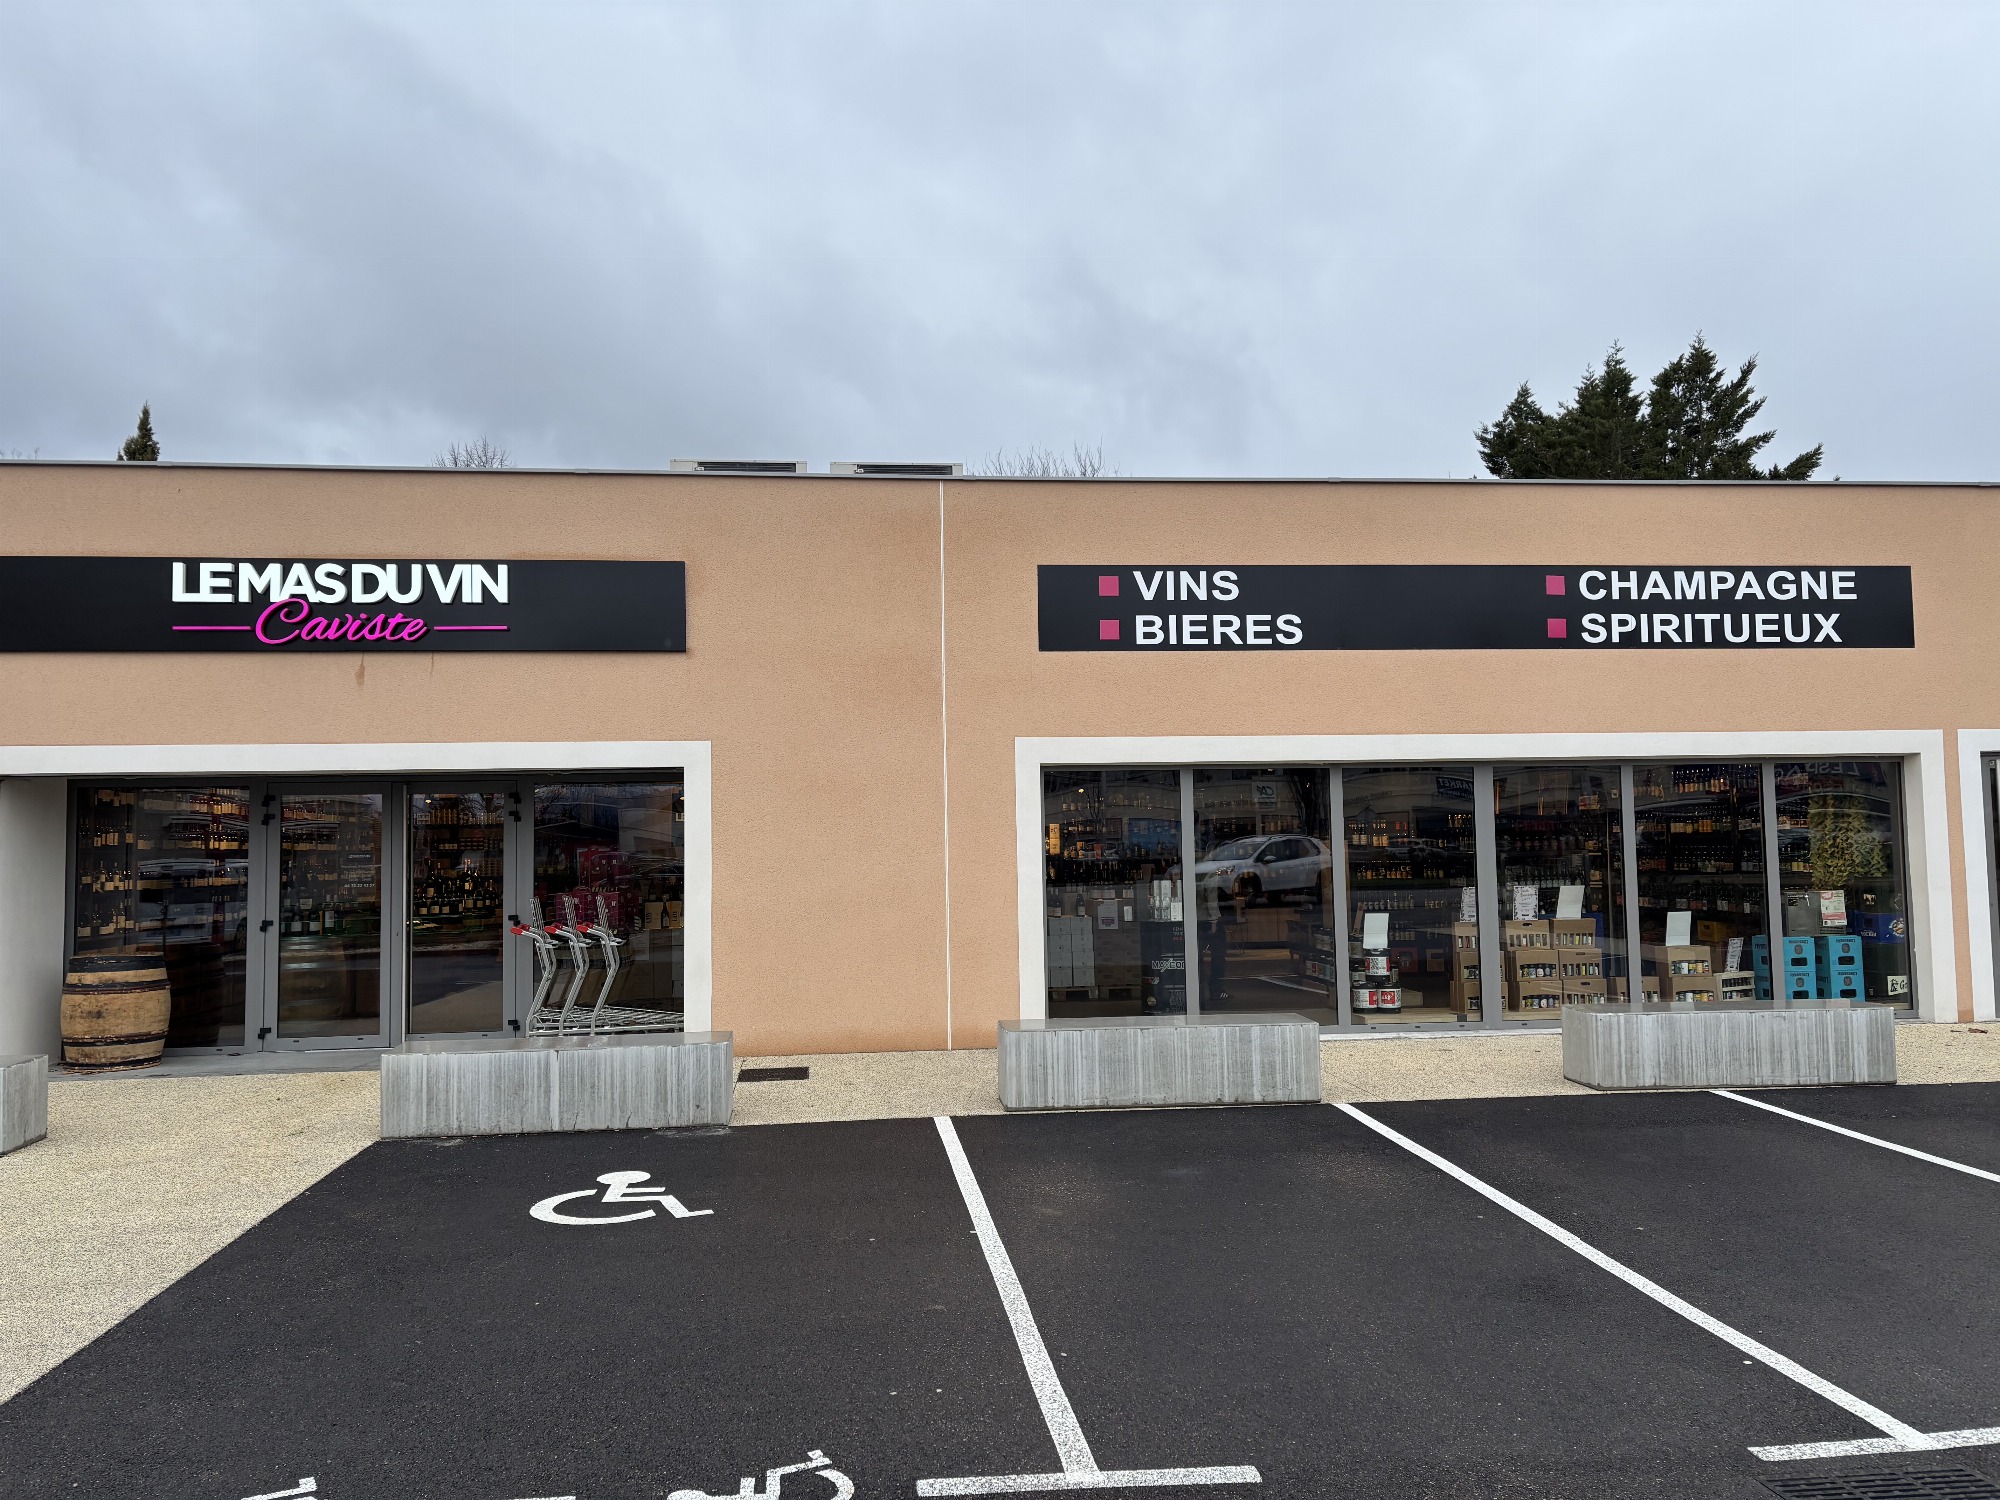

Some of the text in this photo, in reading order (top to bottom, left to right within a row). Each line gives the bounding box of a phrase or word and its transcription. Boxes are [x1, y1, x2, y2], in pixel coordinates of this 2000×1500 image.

[1133, 570, 1240, 601] VINS
[1578, 570, 1858, 600] CHAMPAGNE
[255, 597, 429, 645] Caviste
[1135, 613, 1304, 645] BIERES
[1580, 612, 1843, 644] SPIRITUEUX
